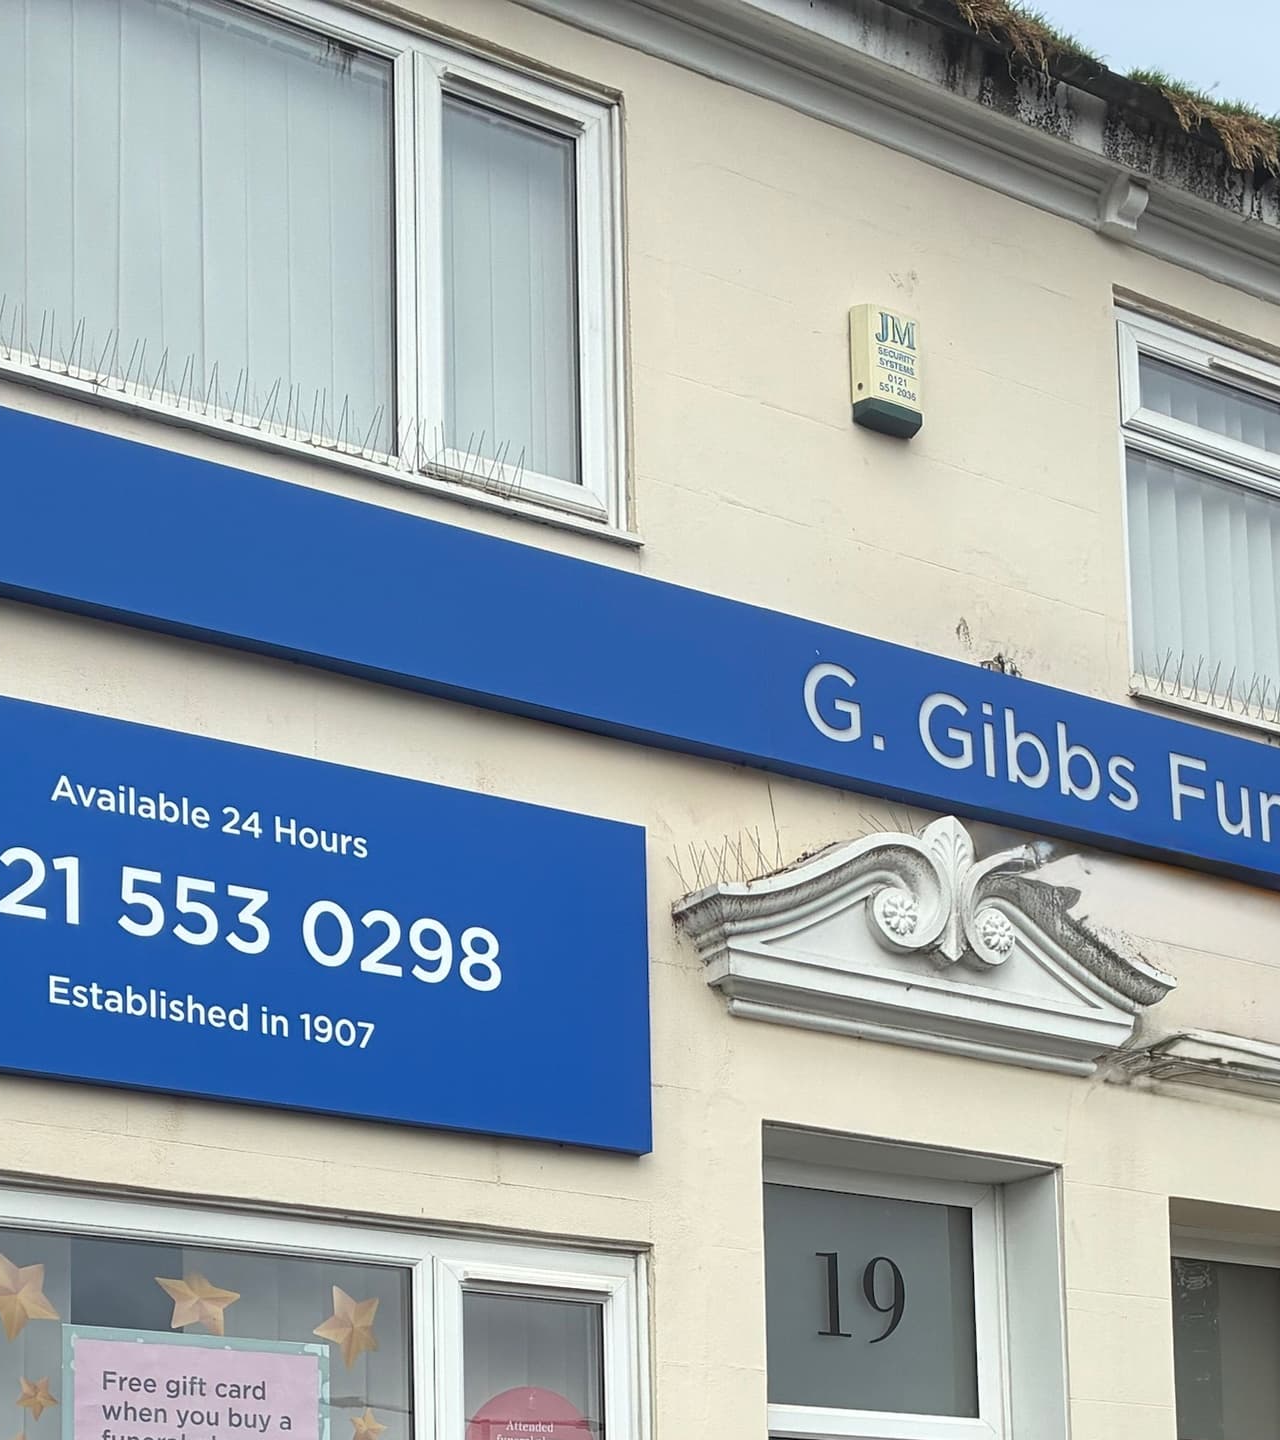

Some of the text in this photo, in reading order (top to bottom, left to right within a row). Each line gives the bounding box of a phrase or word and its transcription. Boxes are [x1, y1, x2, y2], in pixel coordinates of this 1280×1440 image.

[875, 311, 916, 351] JM
[878, 346, 915, 365] SECURITY
[879, 357, 915, 376] SYSTEMS
[879, 381, 894, 393] 551
[888, 373, 907, 387] 0121
[803, 662, 886, 752] G.
[919, 691, 1139, 813] Gibbs
[51, 775, 369, 859] Available 24 Hours
[117, 868, 270, 955] 553
[302, 899, 503, 993] 0298
[48, 975, 376, 1050] Established in 1907
[815, 1251, 906, 1344] 19
[101, 1370, 266, 1400] Free gift card
[101, 1402, 292, 1433] when you buy a
[506, 1420, 554, 1433] Attended
